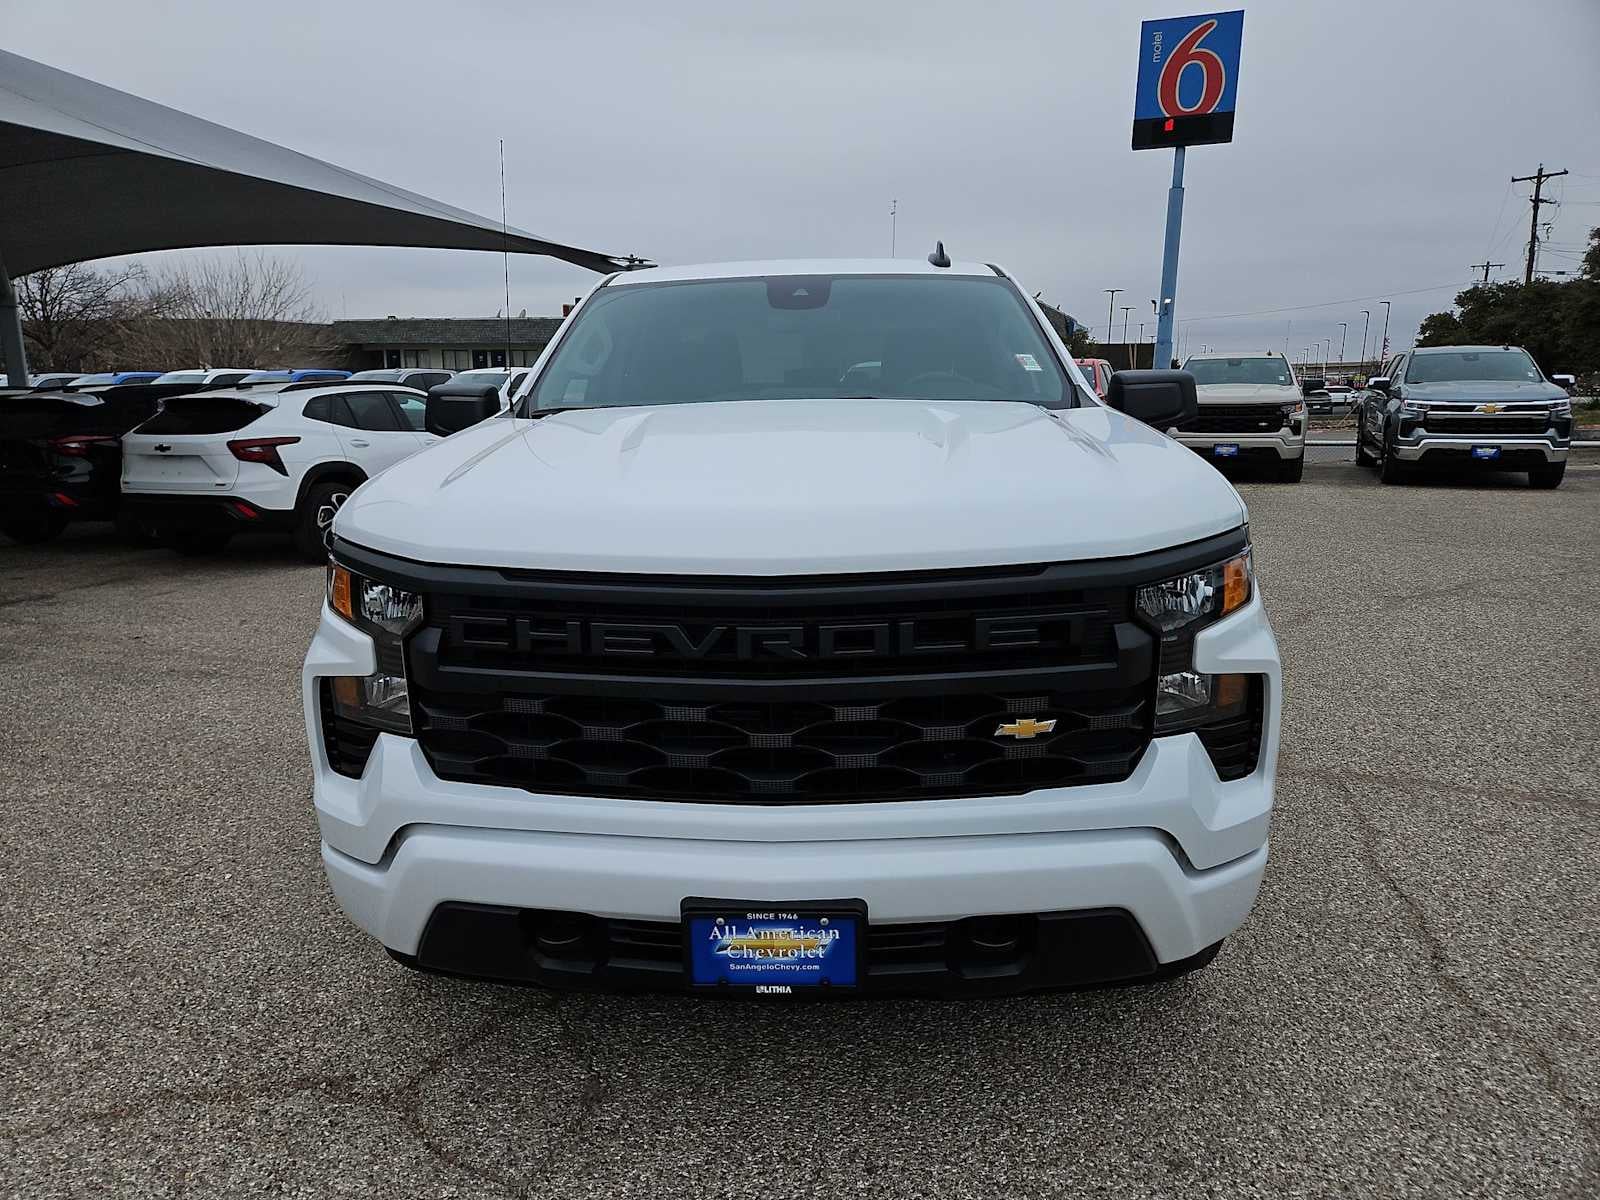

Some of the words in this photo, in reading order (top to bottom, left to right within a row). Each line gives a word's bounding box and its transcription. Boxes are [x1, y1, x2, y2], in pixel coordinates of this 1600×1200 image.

[1152, 31, 1163, 63] motel
[1157, 18, 1226, 118] 6
[448, 609, 1110, 660] CHEVROLET
[746, 912, 775, 920] SINCE
[778, 912, 798, 920] 1946
[709, 925, 737, 940] All
[746, 925, 841, 940] American
[727, 944, 825, 959] Chevrolet
[730, 963, 820, 971] SanAngeloChevy.com
